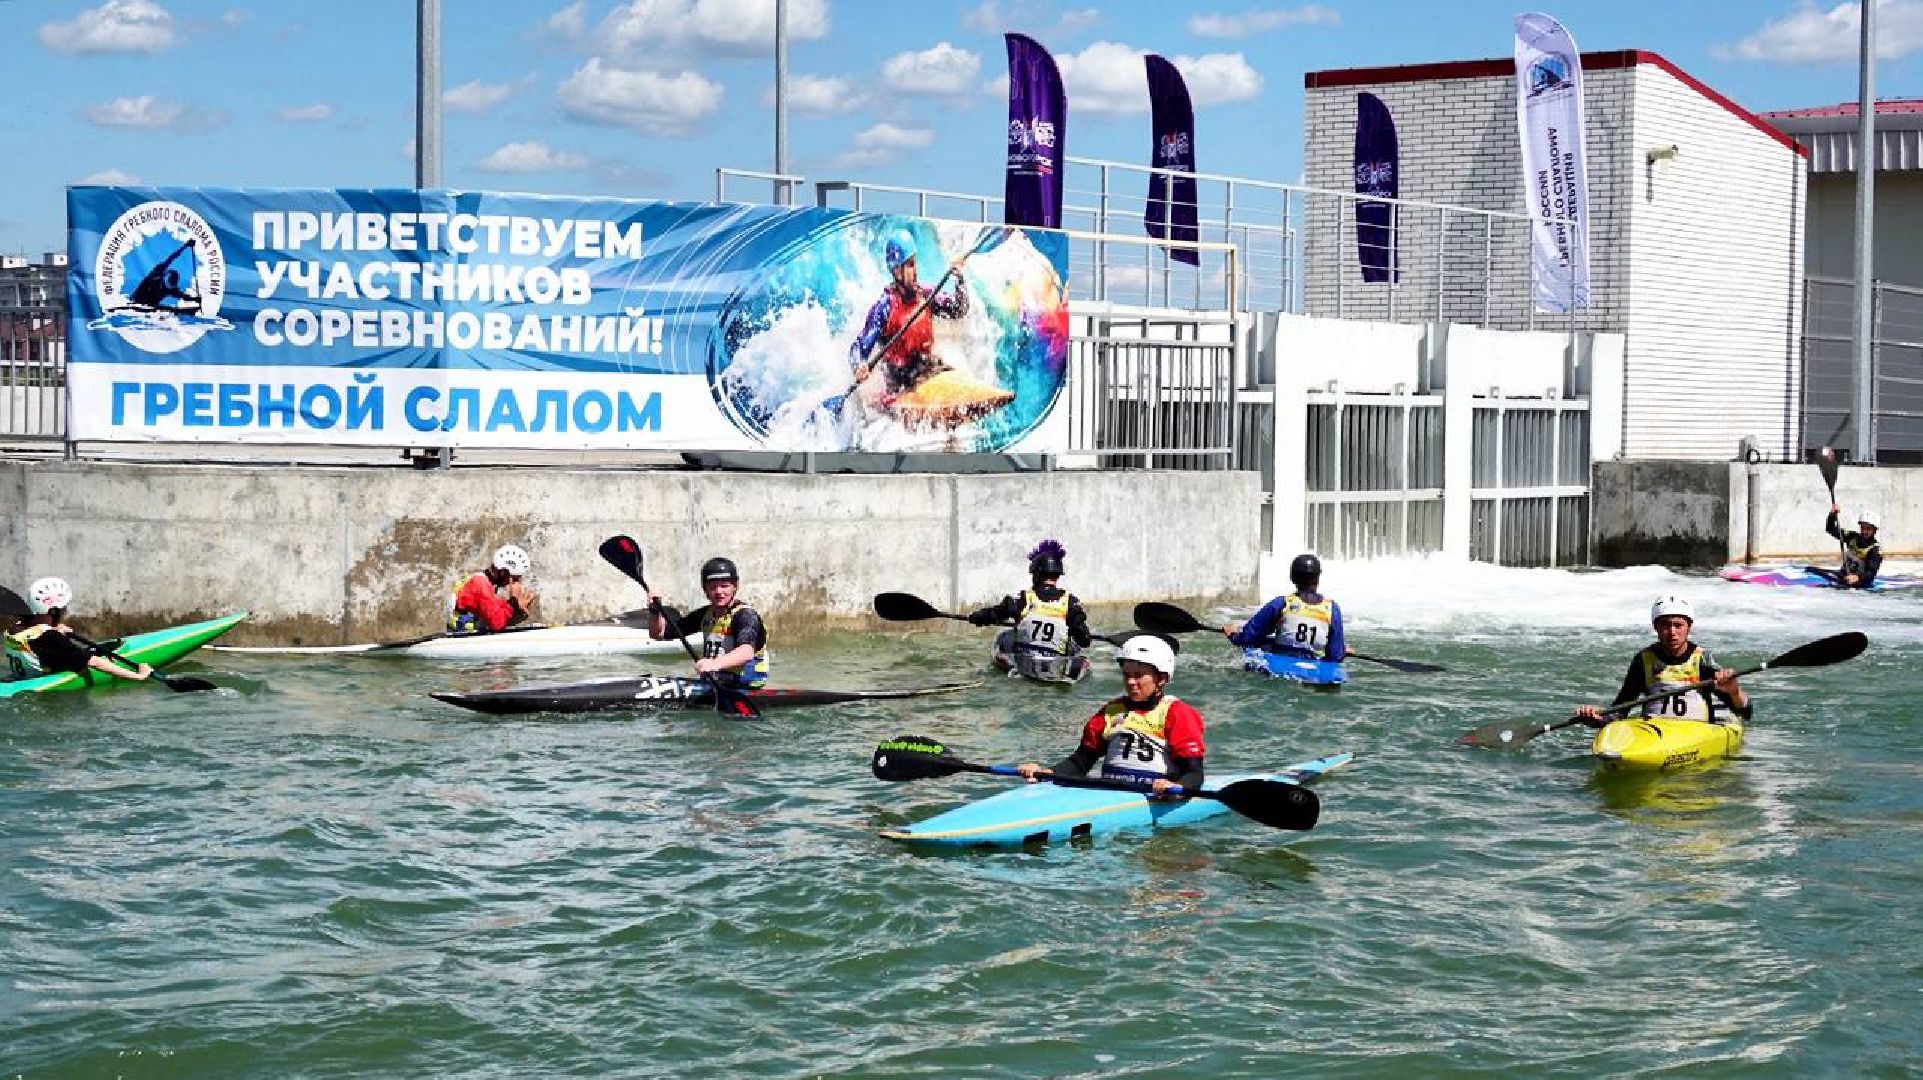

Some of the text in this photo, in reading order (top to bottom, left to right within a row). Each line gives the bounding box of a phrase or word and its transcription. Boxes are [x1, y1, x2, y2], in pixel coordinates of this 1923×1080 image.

[102, 208, 220, 295] ФЕДЕРАЦИЯ ГРЕБНОГО СЛАЛОМА РОССИИ
[252, 211, 644, 259] ПРИВЕТСТВУЕМ
[256, 261, 591, 305] УЧАСТНИКОВ
[253, 307, 664, 354] СОРЕВНОВАНИЙ!
[111, 371, 662, 433] ГРЕБНОЙ СЛАЛОМ
[1032, 620, 1054, 641] 79
[1296, 623, 1317, 645] 81
[1660, 691, 1687, 716] 76
[1120, 732, 1154, 762] 75
